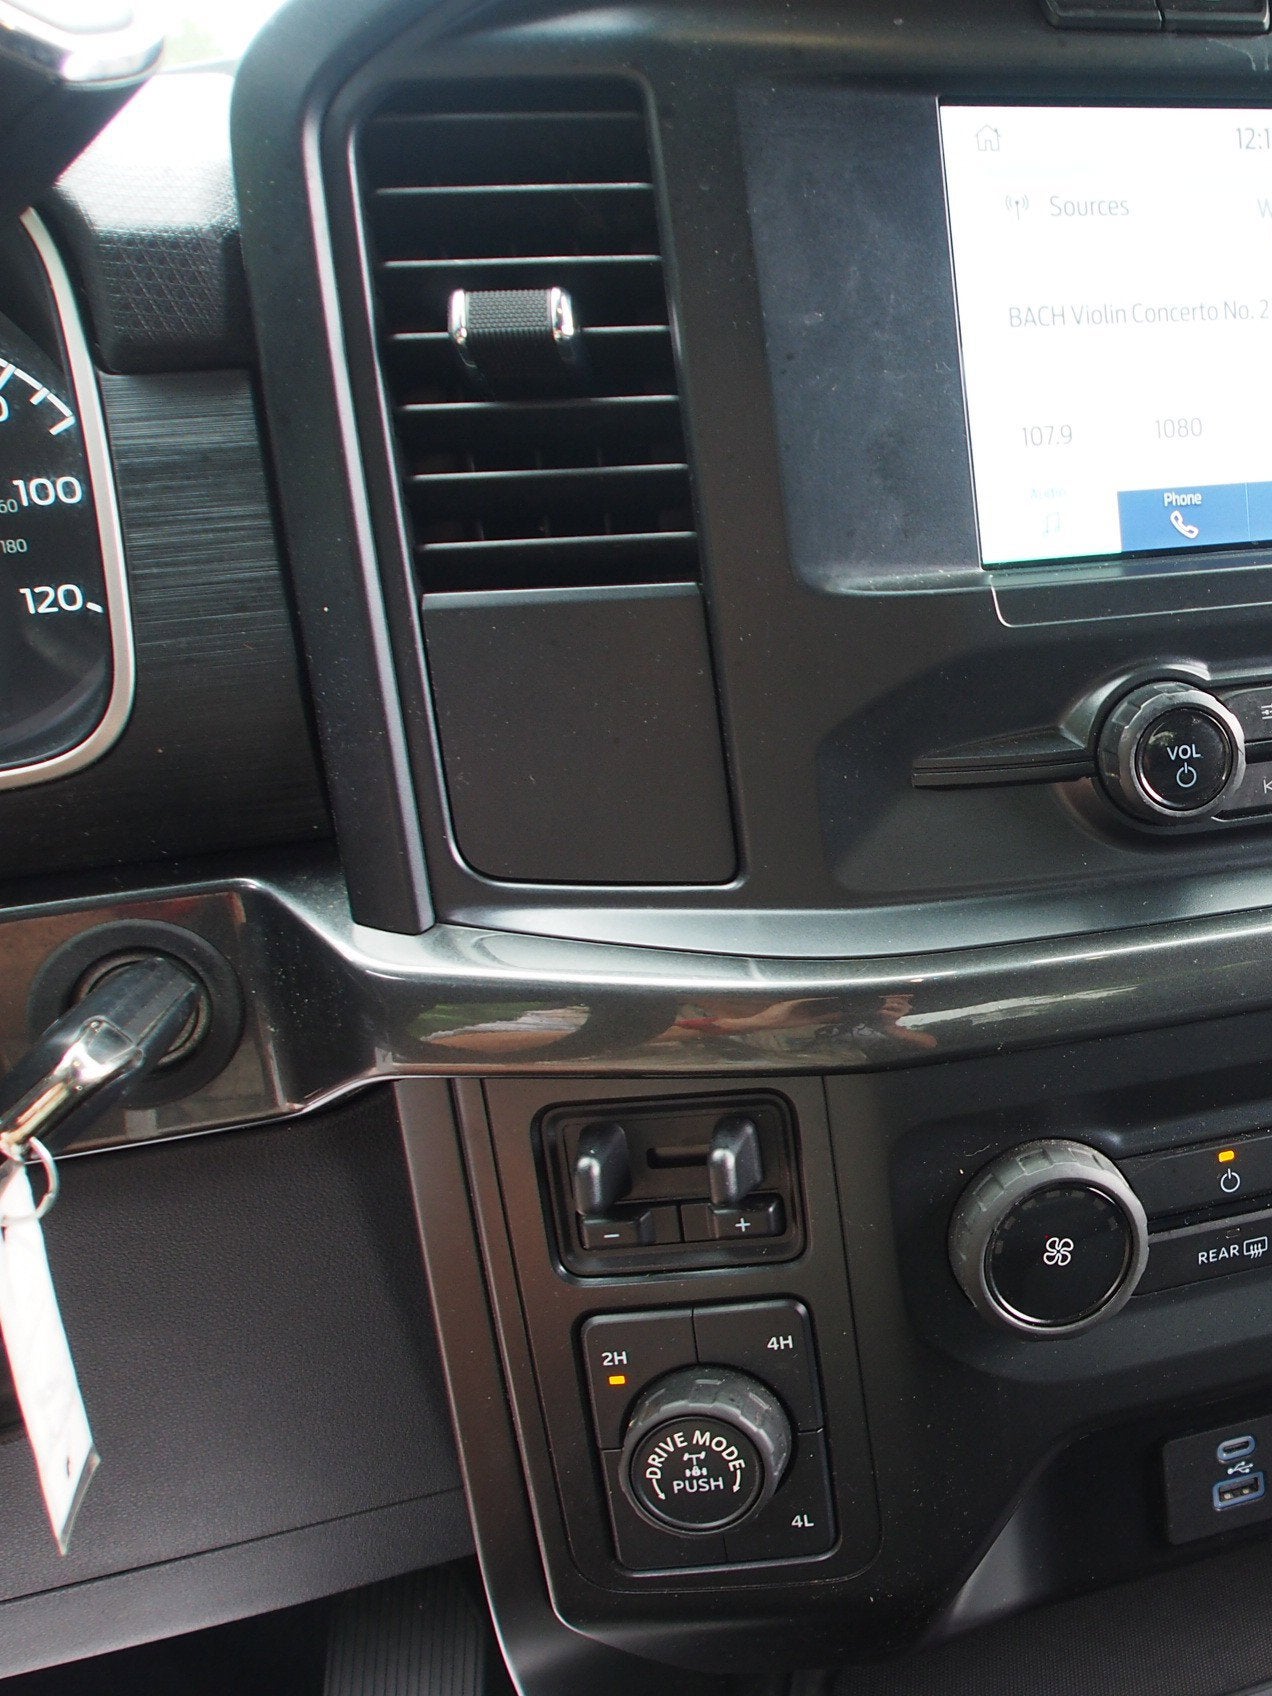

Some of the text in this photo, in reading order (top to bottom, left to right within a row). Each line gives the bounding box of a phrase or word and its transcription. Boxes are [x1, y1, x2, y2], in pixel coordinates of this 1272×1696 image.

[1050, 196, 1129, 216] Sources
[1009, 306, 1065, 327] BACH
[1071, 304, 1126, 325] Violin
[1132, 303, 1218, 323] Concerto
[1224, 301, 1254, 319] No.
[1259, 299, 1270, 320] 2
[1023, 424, 1072, 446] 107.9
[1156, 417, 1202, 438] 1080
[12, 476, 82, 507] 100
[1163, 491, 1202, 506] Phone
[18, 584, 83, 614] 120
[1167, 744, 1201, 760] VOL
[1199, 1245, 1239, 1264] REAR
[767, 1335, 793, 1350] 4H
[602, 1351, 627, 1365] 2H
[646, 1430, 745, 1479] DRIVE MODE
[673, 1477, 723, 1493] PUSH
[792, 1515, 814, 1527] 4L
